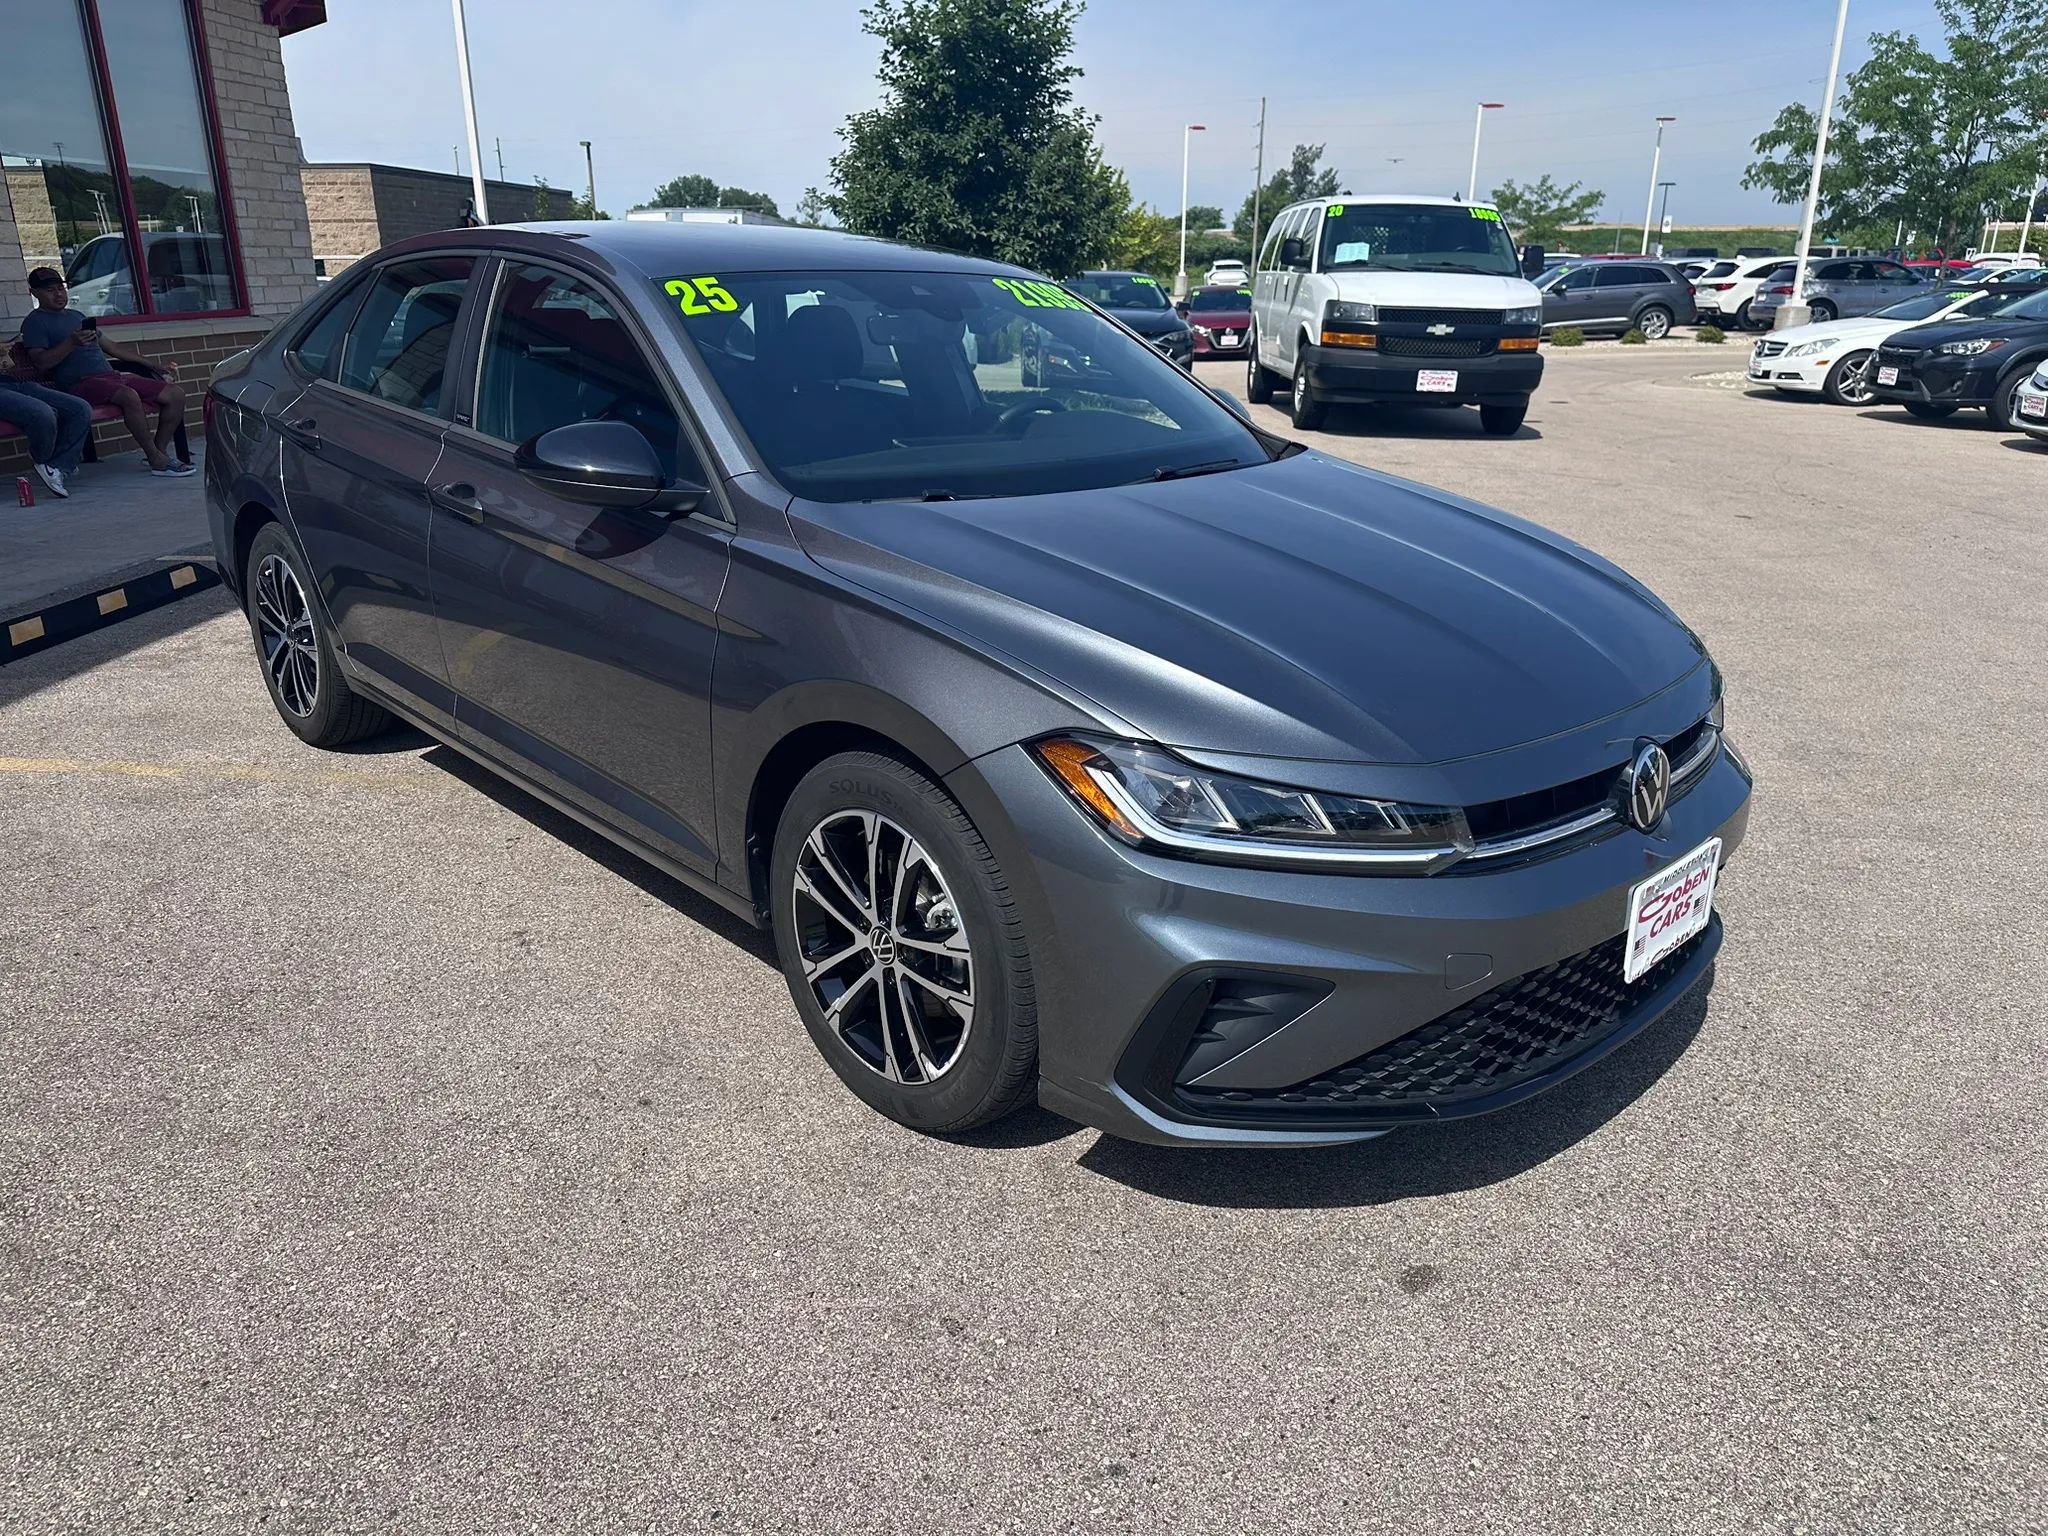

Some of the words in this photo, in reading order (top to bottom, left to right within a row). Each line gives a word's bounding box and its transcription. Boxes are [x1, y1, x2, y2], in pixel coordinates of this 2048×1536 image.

[1327, 205, 1344, 218] 20
[664, 276, 738, 316] 25
[992, 278, 1094, 313] 21995
[829, 778, 894, 805] SOLUS
[1650, 894, 1693, 938] CARS
